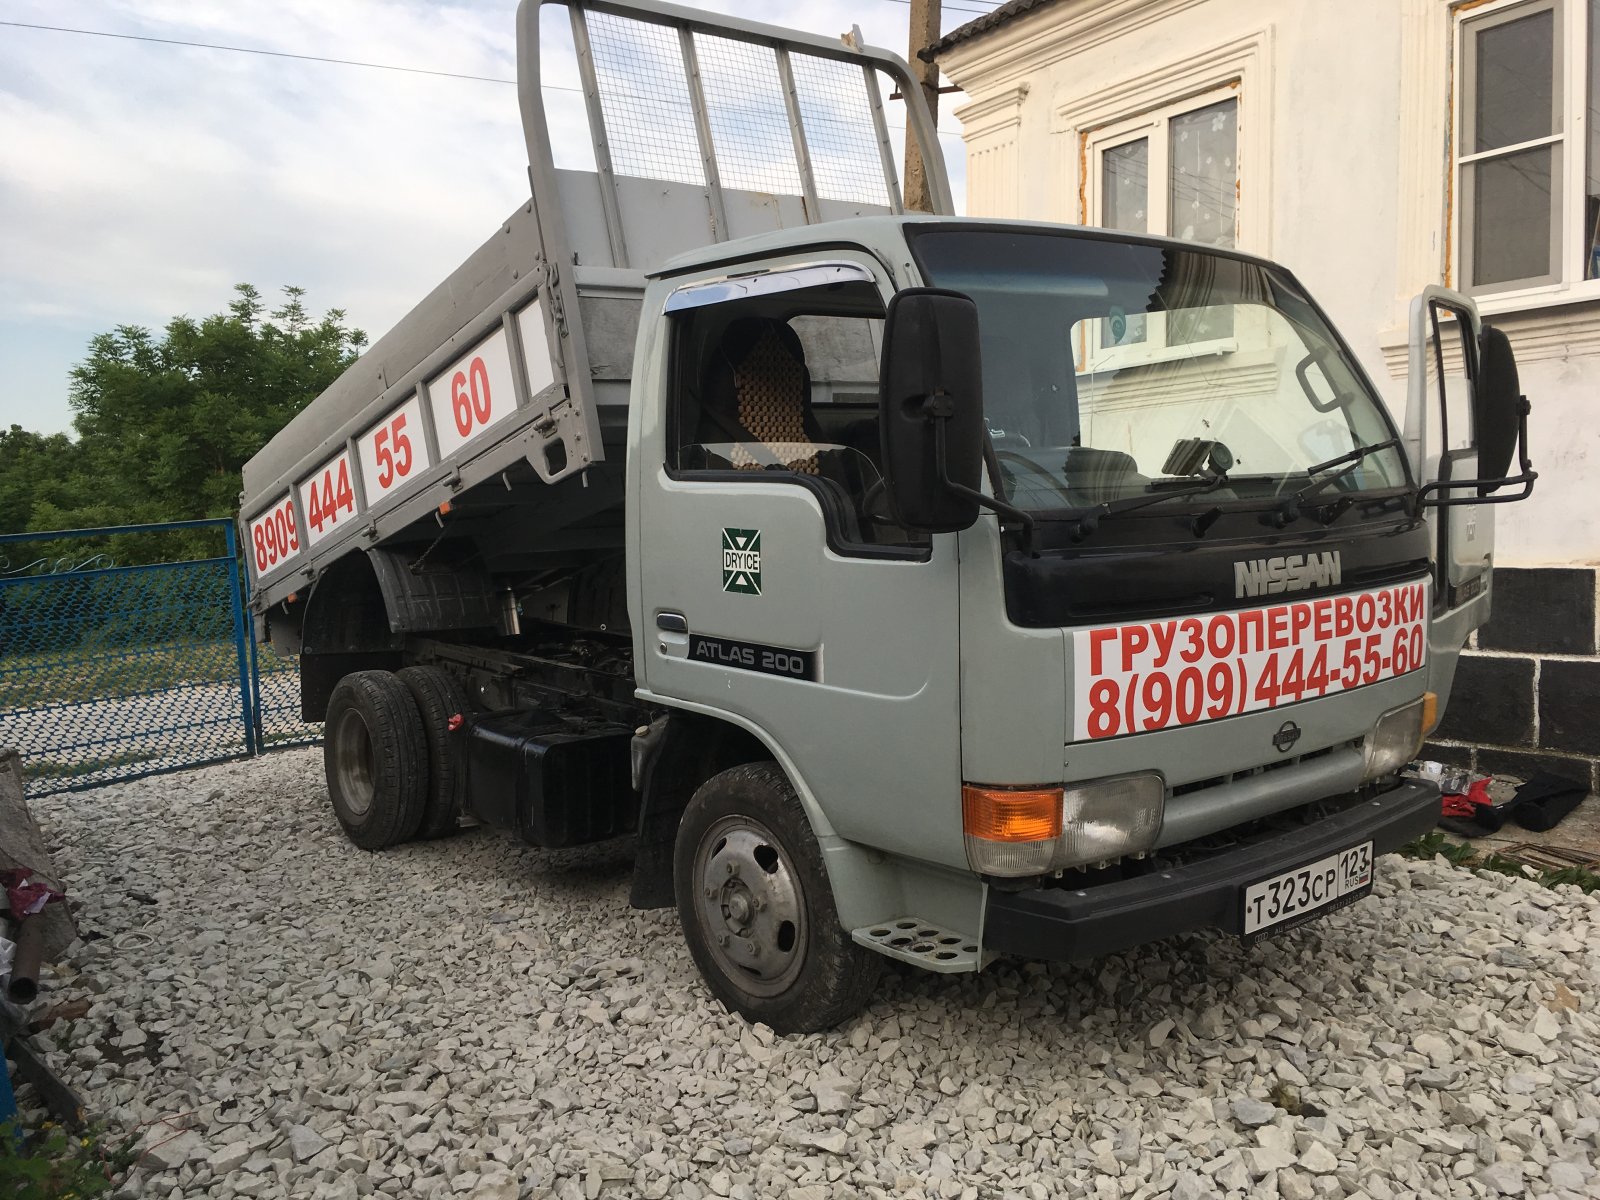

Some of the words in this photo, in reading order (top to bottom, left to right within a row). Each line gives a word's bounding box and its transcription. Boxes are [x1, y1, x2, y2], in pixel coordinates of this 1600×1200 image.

[254, 500, 299, 572] 8909
[308, 458, 354, 533] 444
[374, 412, 412, 489] 55
[451, 356, 492, 437] 60
[1233, 550, 1341, 599] NISSAN
[1090, 583, 1424, 676] ГРУЗОПЕРЕВОЗКИ
[696, 640, 755, 665] ATLAS
[762, 651, 804, 674] 200
[1340, 846, 1368, 880] 123
[1344, 875, 1359, 890] RUS
